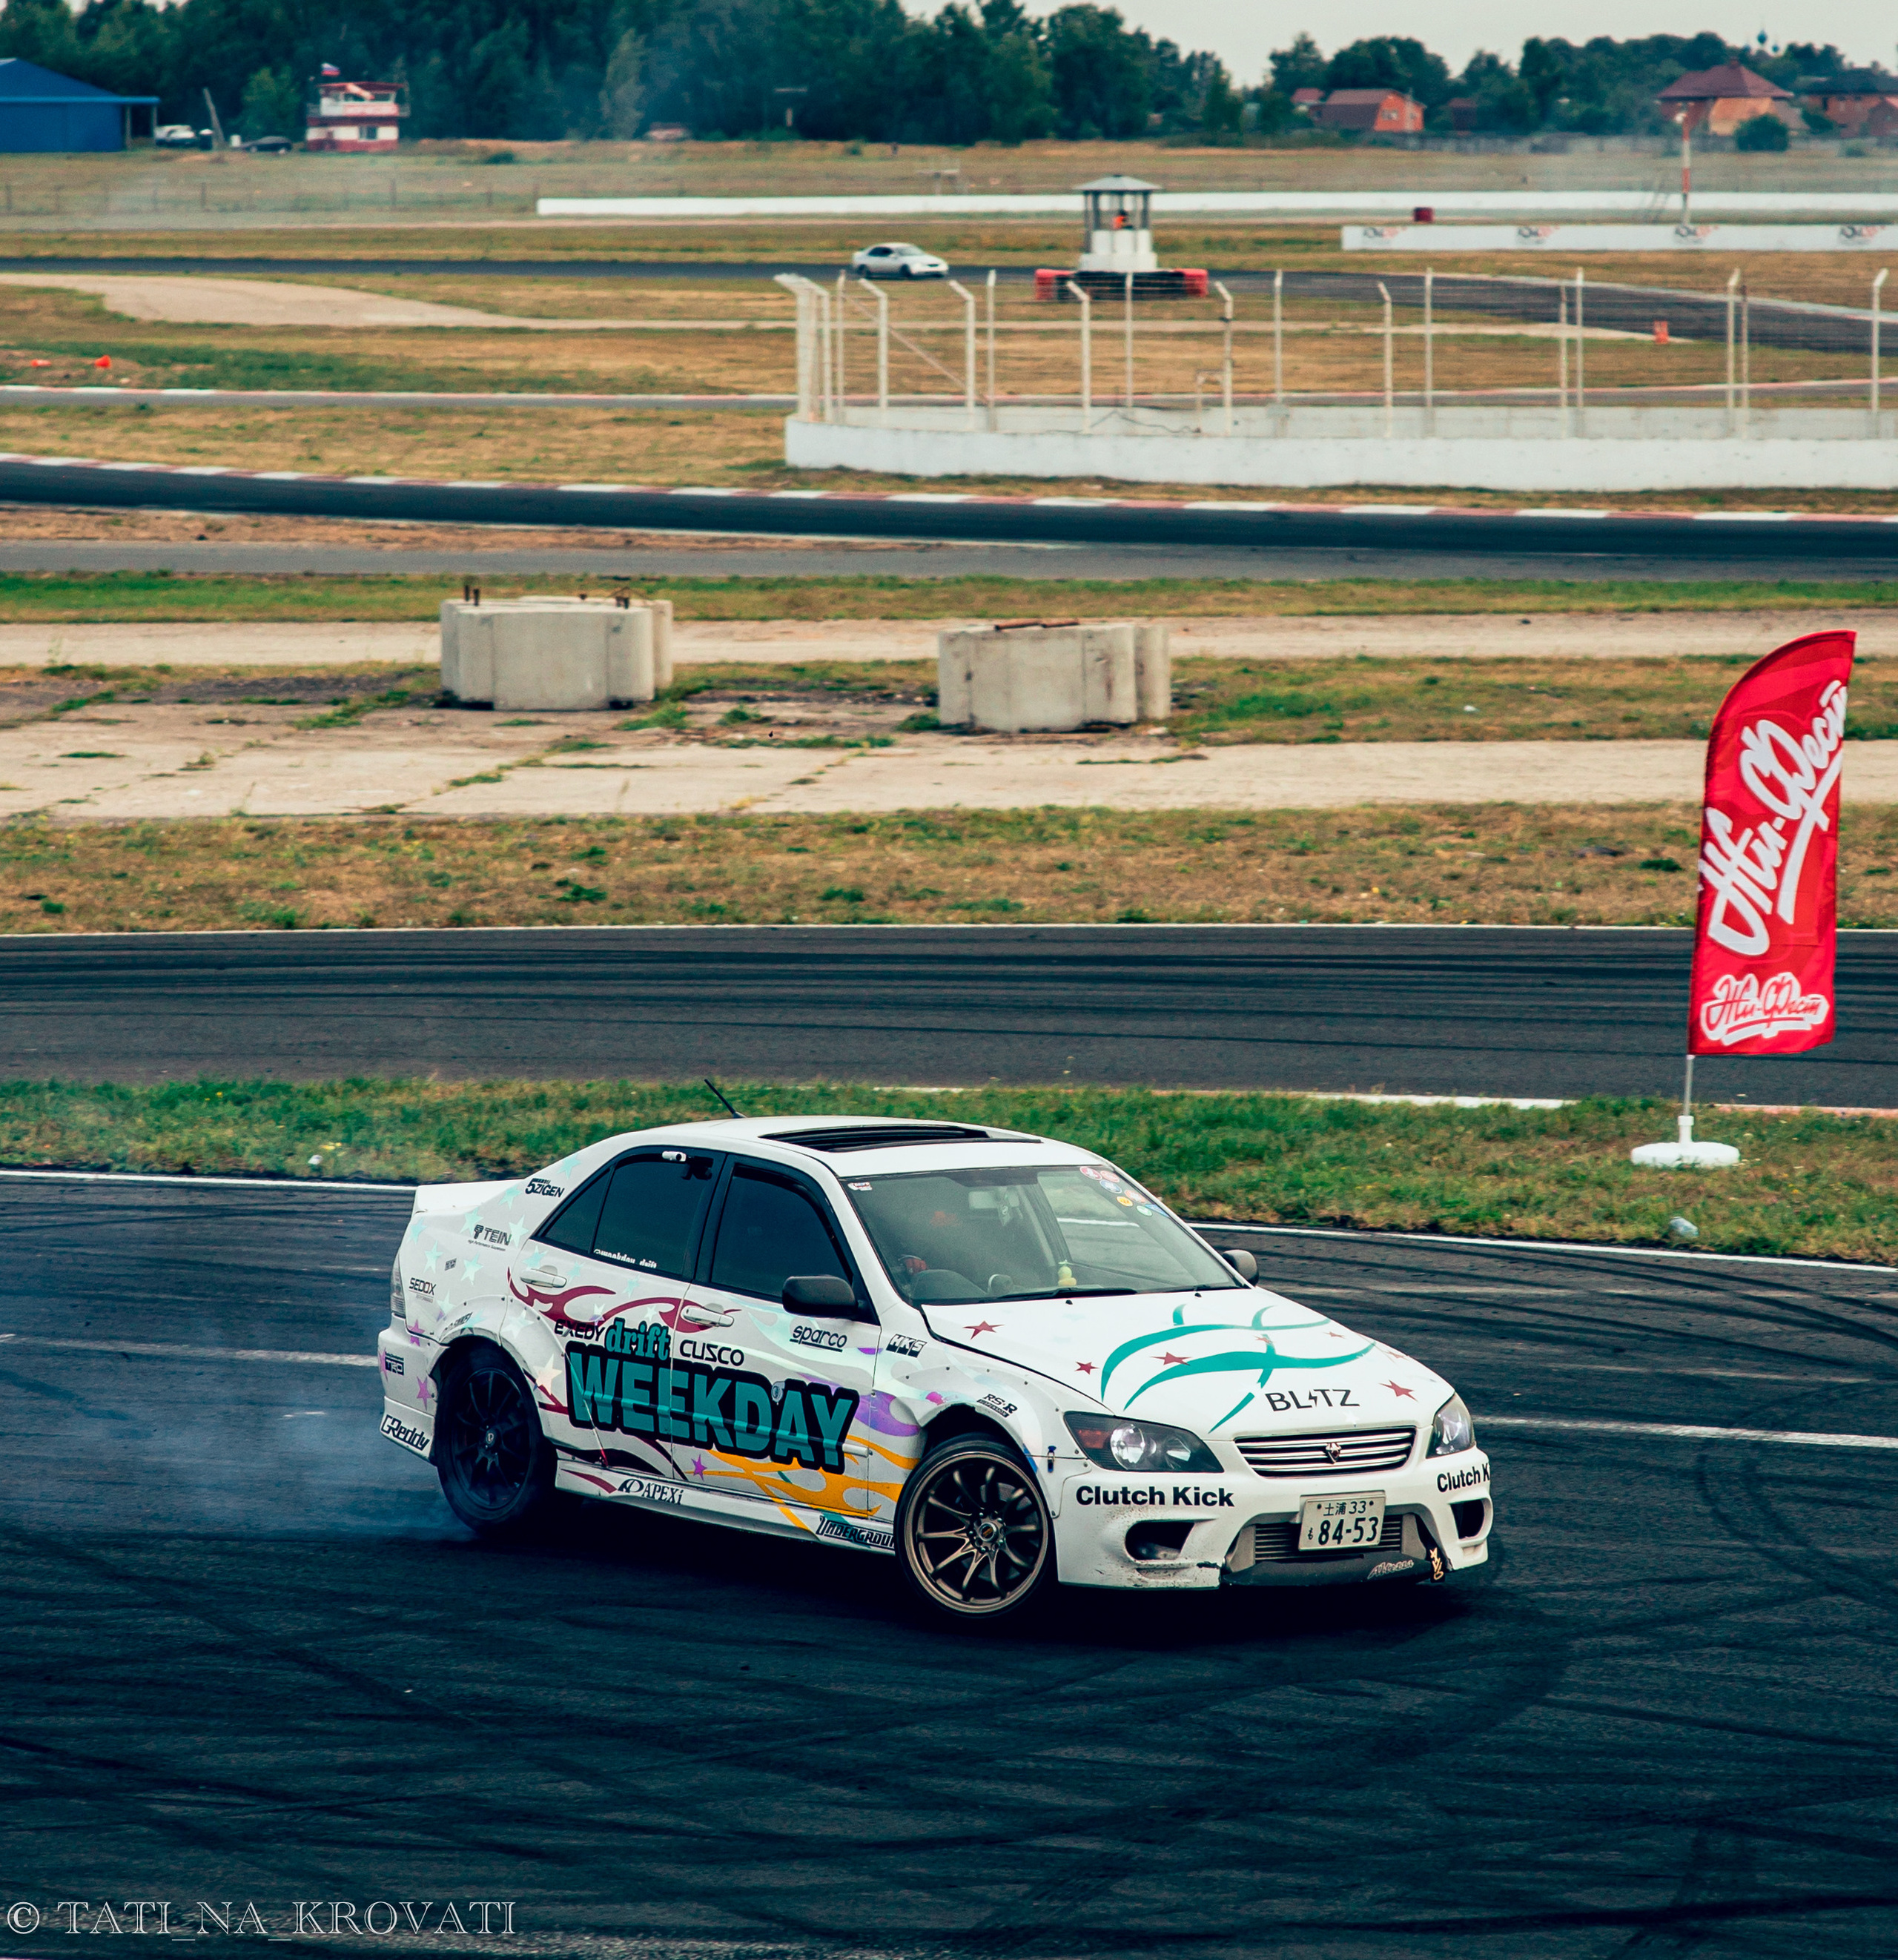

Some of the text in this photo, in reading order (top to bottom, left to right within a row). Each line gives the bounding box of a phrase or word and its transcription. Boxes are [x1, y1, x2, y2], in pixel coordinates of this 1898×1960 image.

[525, 1177, 565, 1198] 5ZIGEN
[483, 1226, 512, 1246] TEIN
[409, 1277, 437, 1296] SEDOX
[554, 1318, 606, 1342] EXEDY
[604, 1319, 670, 1361] drift
[792, 1325, 848, 1349] sparco
[678, 1339, 745, 1367] CUSCO
[887, 1334, 927, 1356] HKS
[569, 1351, 854, 1467] WEEKDAY
[1265, 1388, 1360, 1412] BLITZ
[1437, 1466, 1481, 1493] Clutch
[1076, 1485, 1235, 1507] Clutch Kick
[1323, 1500, 1367, 1517] 土浦 33
[1317, 1517, 1379, 1546] 84-53
